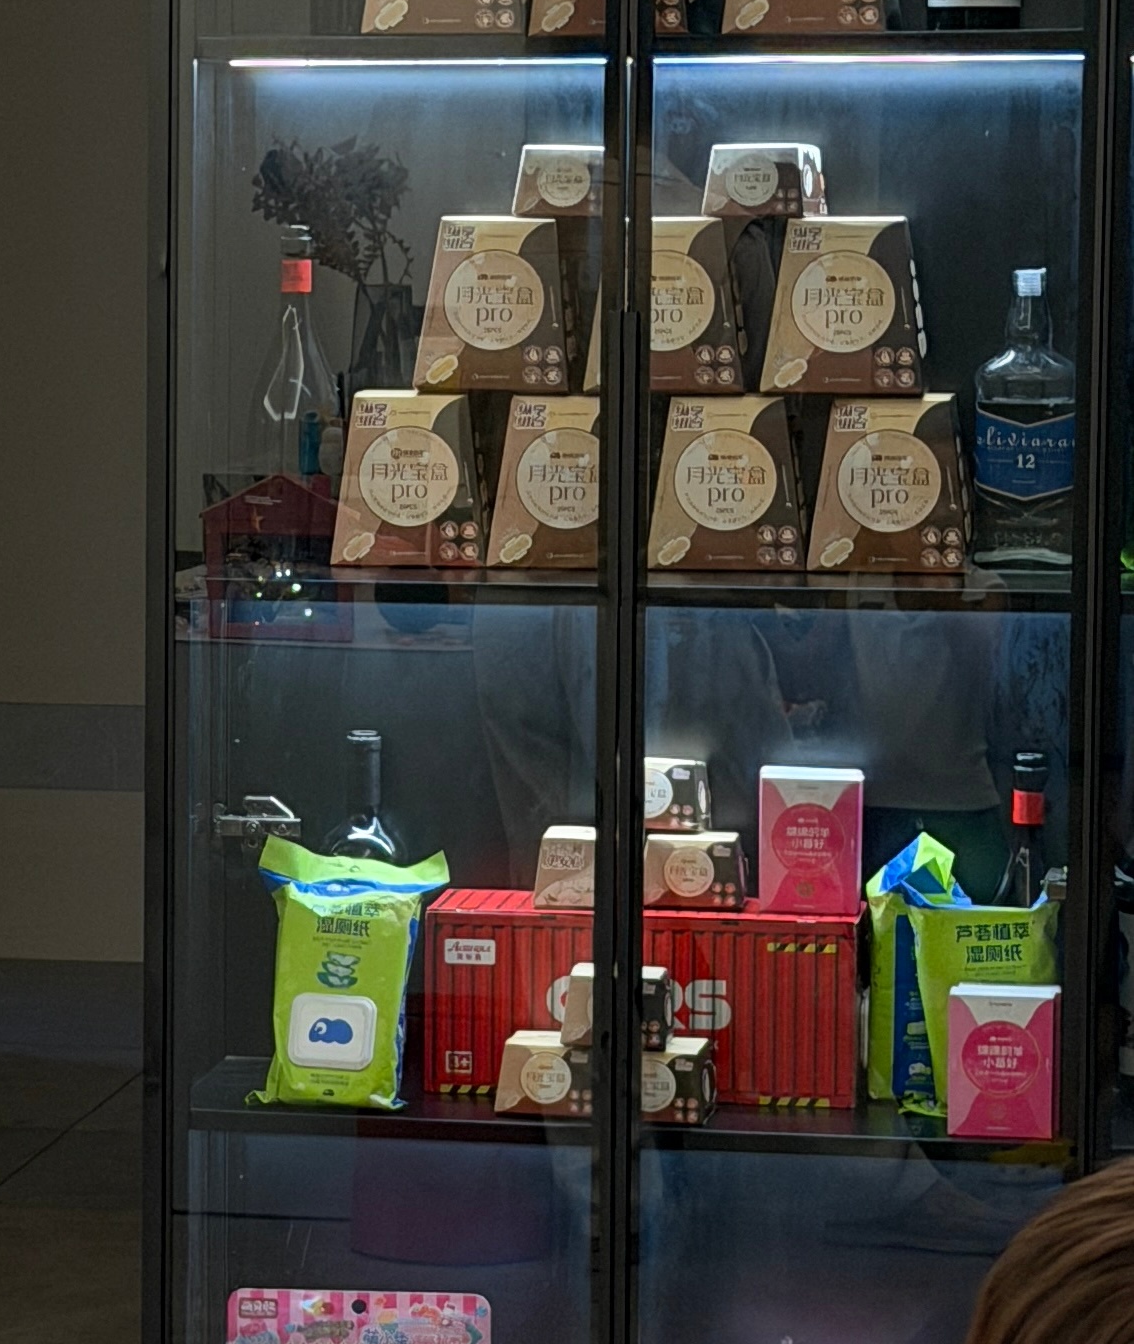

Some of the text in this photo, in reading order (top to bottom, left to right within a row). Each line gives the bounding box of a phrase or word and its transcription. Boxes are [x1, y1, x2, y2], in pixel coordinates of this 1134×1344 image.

[457, 286, 533, 305] 月光宝盒
[651, 287, 704, 305] 光宝盒
[803, 288, 884, 306] 月光宝盒
[476, 307, 513, 327] pro
[825, 309, 863, 329] pro
[1017, 454, 1035, 469] 12
[371, 462, 448, 481] 月光宝盒
[687, 465, 766, 485] 月光宝盒
[850, 467, 930, 486] 月光宝盒
[391, 484, 428, 503] pro
[549, 486, 586, 505] pro
[708, 487, 745, 507] pro
[871, 488, 909, 508] pro
[956, 922, 1030, 943] 芦荟植萃
[966, 944, 1022, 964] 湿厕纸
